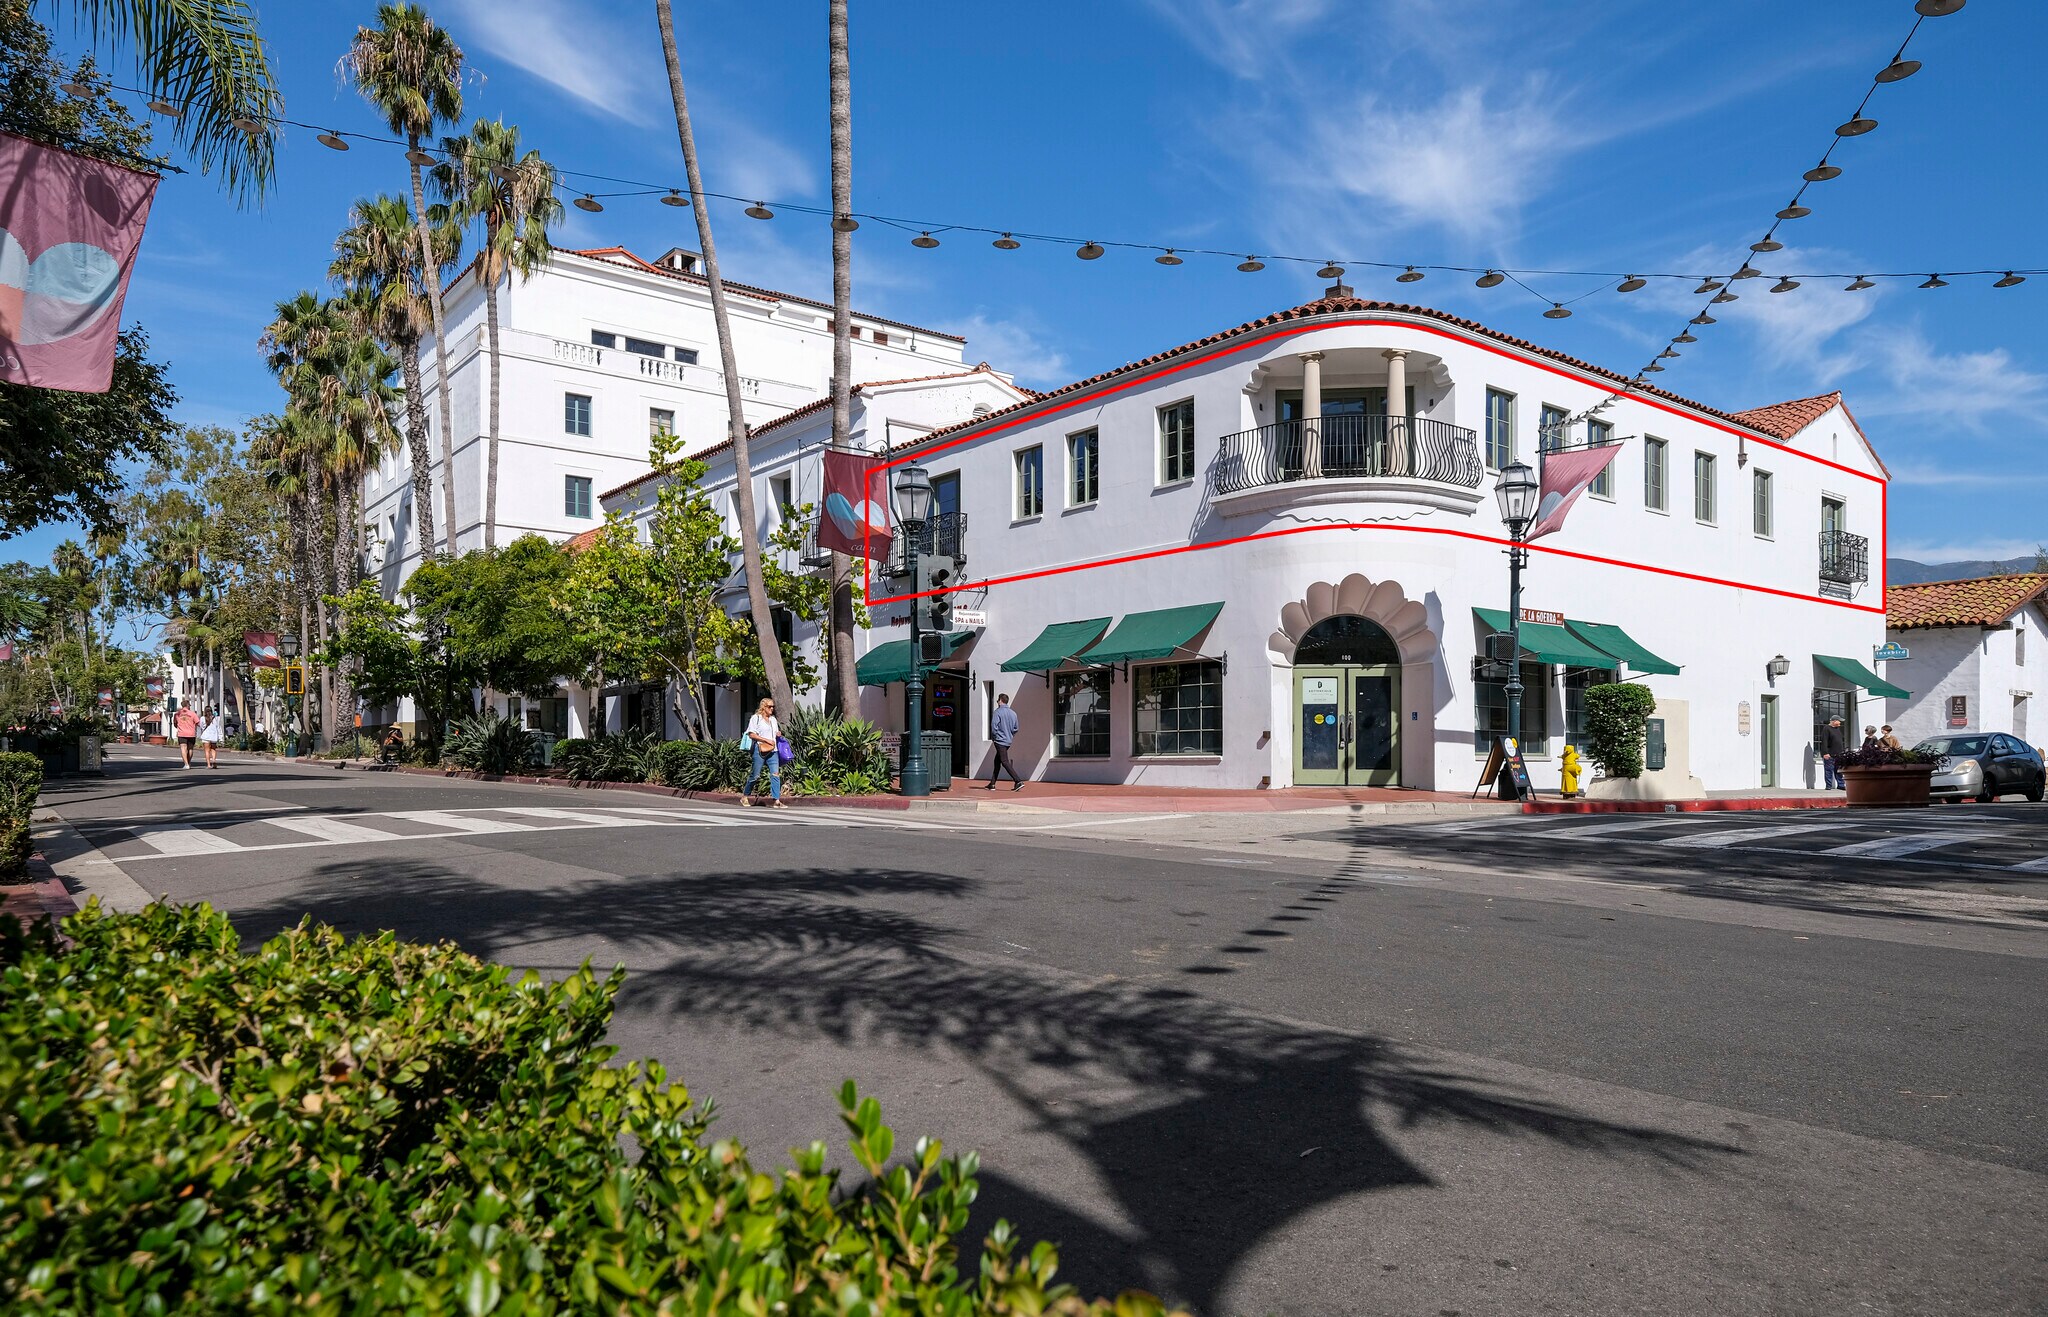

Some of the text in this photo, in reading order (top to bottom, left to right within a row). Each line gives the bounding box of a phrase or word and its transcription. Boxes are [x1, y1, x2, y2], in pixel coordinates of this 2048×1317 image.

[1520, 609, 1527, 621] DE
[1528, 610, 1535, 621] LA
[955, 616, 965, 624] SPA
[969, 617, 985, 625] NAILS
